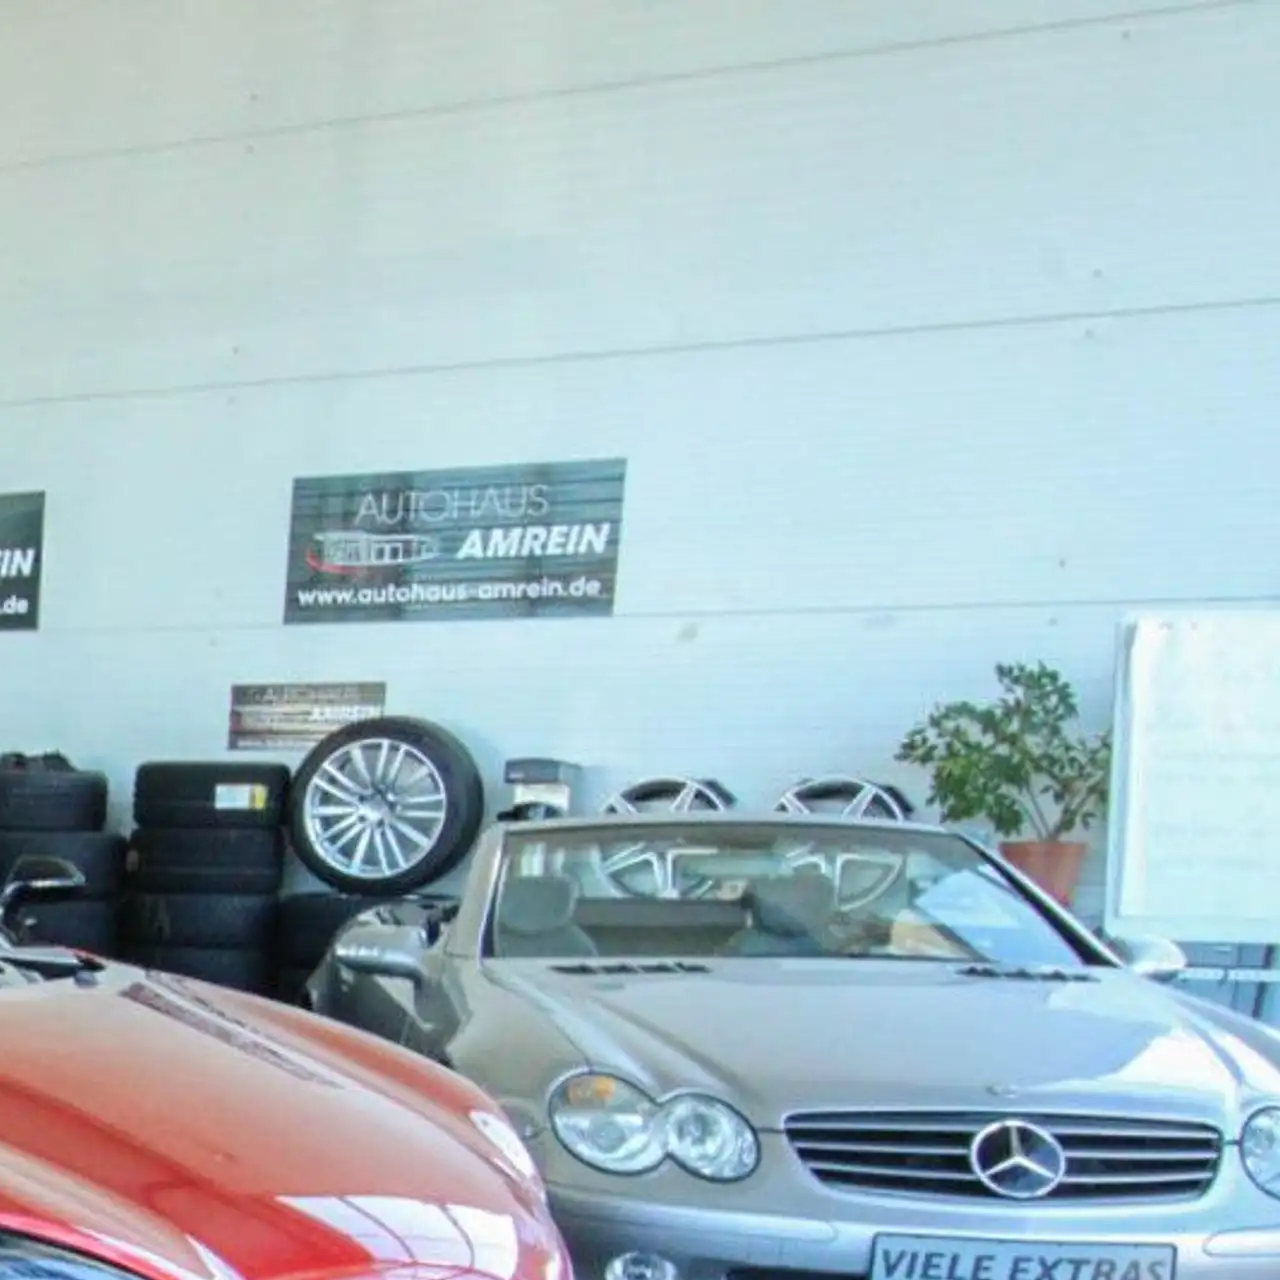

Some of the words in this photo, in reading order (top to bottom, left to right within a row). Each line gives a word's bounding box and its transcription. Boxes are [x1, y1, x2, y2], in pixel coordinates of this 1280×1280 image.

[353, 485, 550, 525] AUTOHAUS
[455, 522, 611, 560] AMREIN
[298, 575, 601, 606] www.autohaus-amrein.de
